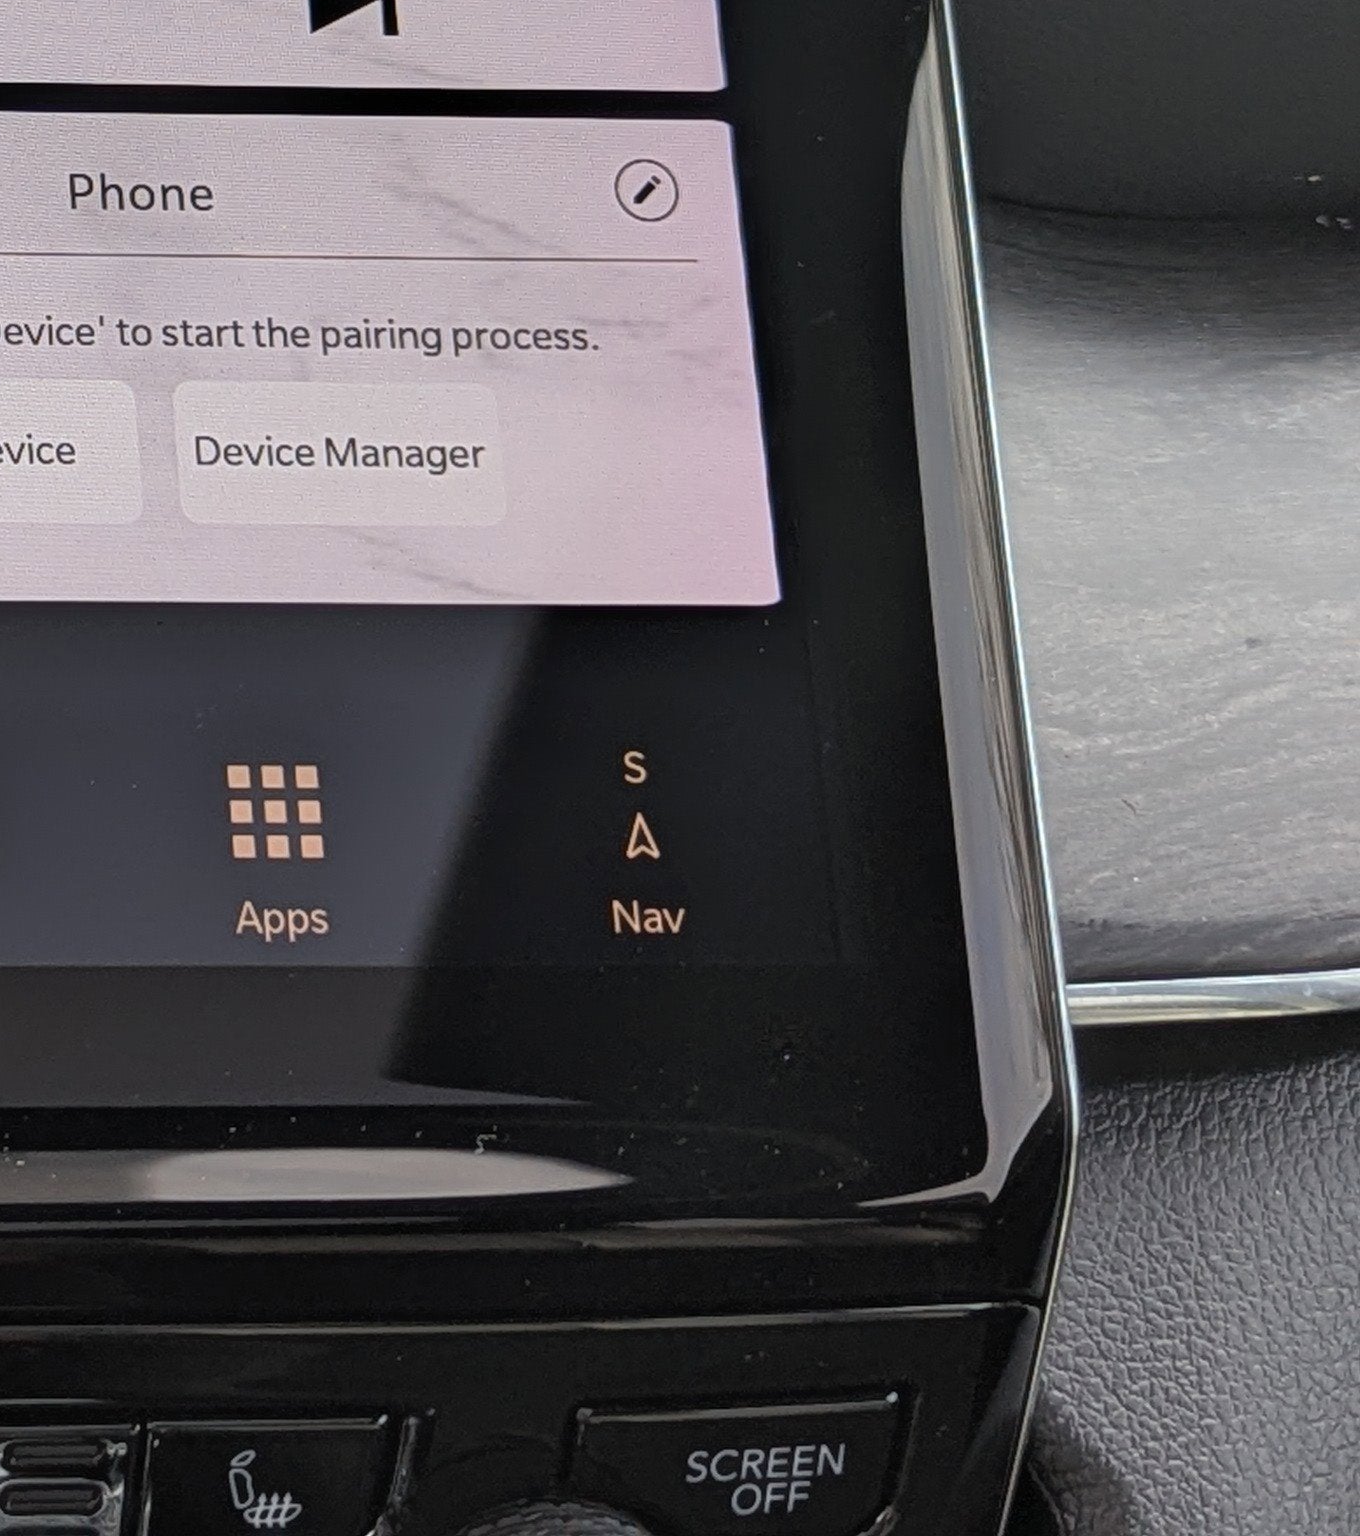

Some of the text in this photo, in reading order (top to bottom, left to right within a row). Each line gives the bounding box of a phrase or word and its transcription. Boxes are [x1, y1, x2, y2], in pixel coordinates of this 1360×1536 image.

[69, 173, 215, 212] Phone
[117, 319, 151, 346] to
[162, 319, 244, 348] start
[252, 318, 310, 348] the
[321, 319, 442, 356] pairing
[452, 325, 600, 357] process.
[195, 436, 485, 476] Device Manager
[624, 751, 646, 783] S
[235, 901, 330, 936] Apps
[611, 901, 685, 934] Nav
[685, 1443, 846, 1484] SCREEN
[731, 1480, 811, 1516] OFF
